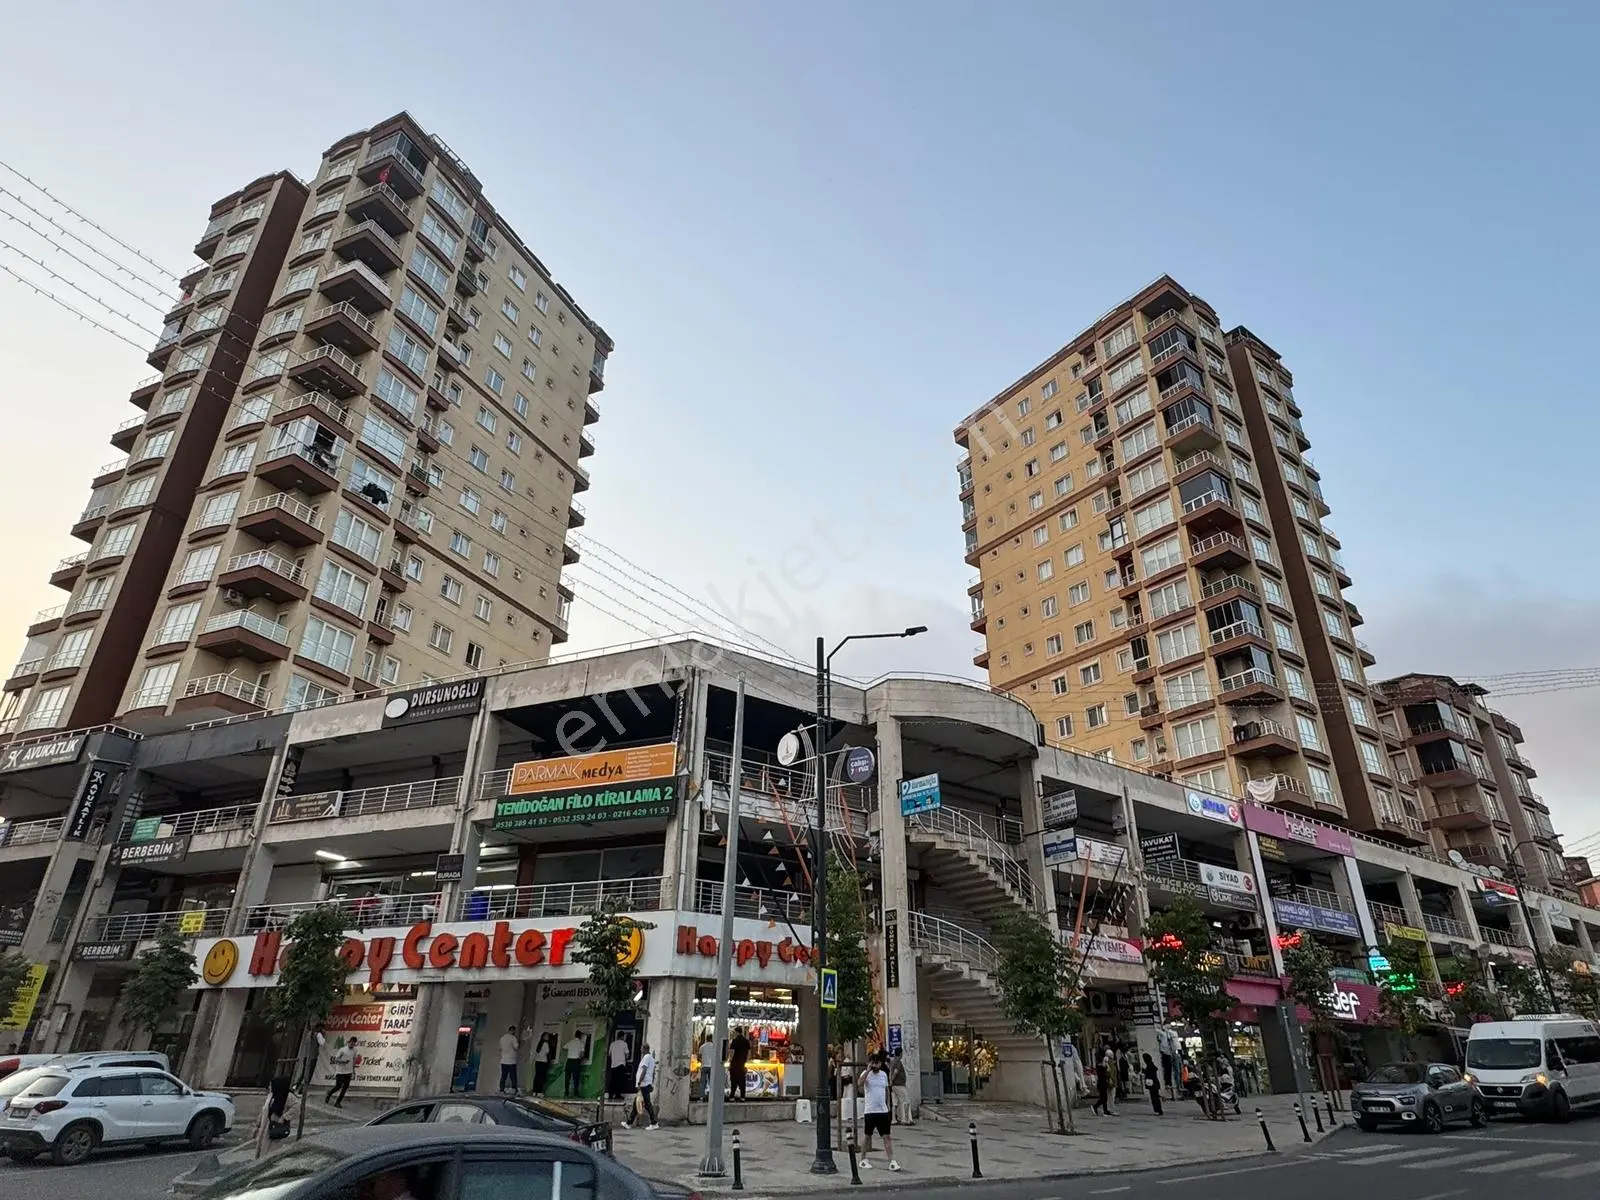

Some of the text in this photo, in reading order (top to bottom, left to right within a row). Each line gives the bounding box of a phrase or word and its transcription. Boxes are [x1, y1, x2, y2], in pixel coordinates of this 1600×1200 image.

[22, 738, 80, 761] AVUKATLIK
[496, 786, 674, 817] YENİDOĞAN FİLO KİRALAMA 2
[73, 784, 99, 838] AVUKATLIK
[121, 841, 174, 860] BERBERİM
[1218, 870, 1240, 884] SİYAD
[82, 943, 121, 957] BERBERİM
[402, 920, 577, 969] Center
[550, 987, 576, 999] Garanti
[390, 1003, 415, 1018] GİRİŞ
[362, 1056, 383, 1066] Ticket
